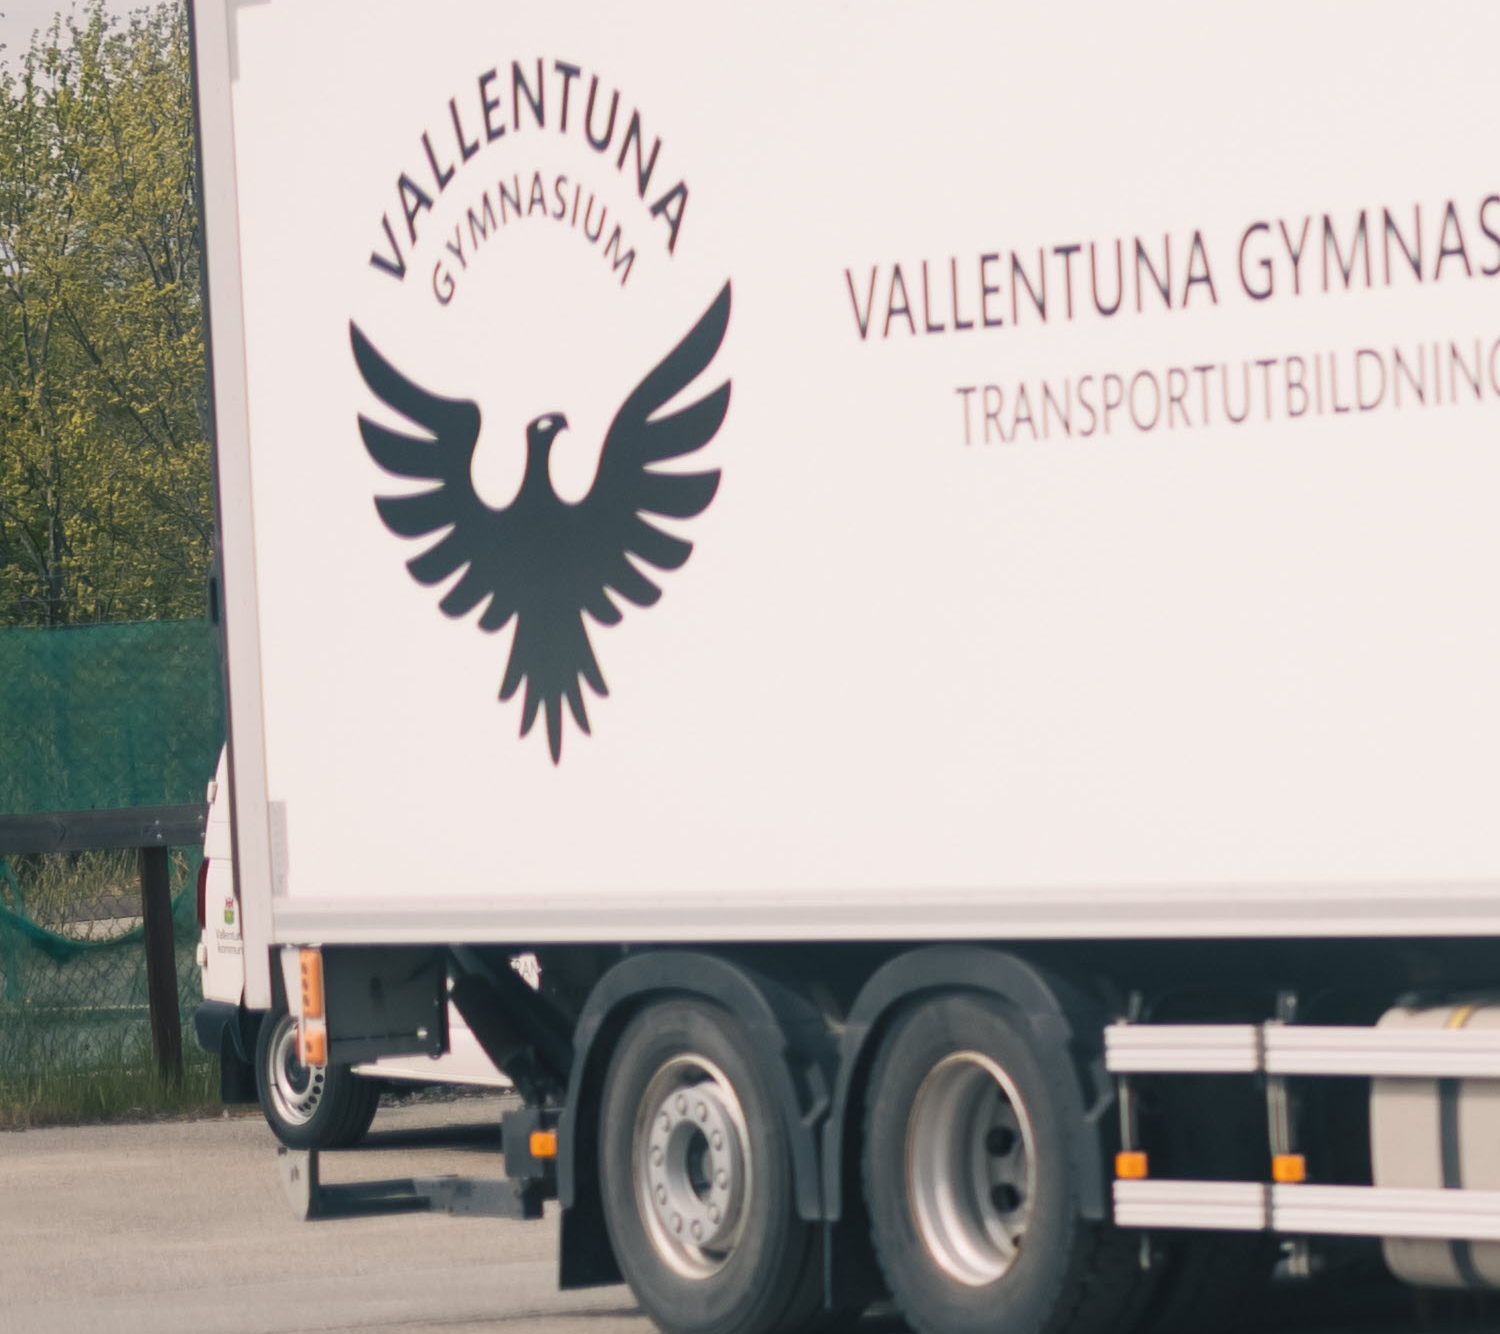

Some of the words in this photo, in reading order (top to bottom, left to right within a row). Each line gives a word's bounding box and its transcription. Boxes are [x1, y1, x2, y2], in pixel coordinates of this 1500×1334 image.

[369, 57, 690, 281] VALLENTUNA
[431, 170, 638, 306] GYMNASIUM
[845, 229, 1218, 341] VALLENTUNA
